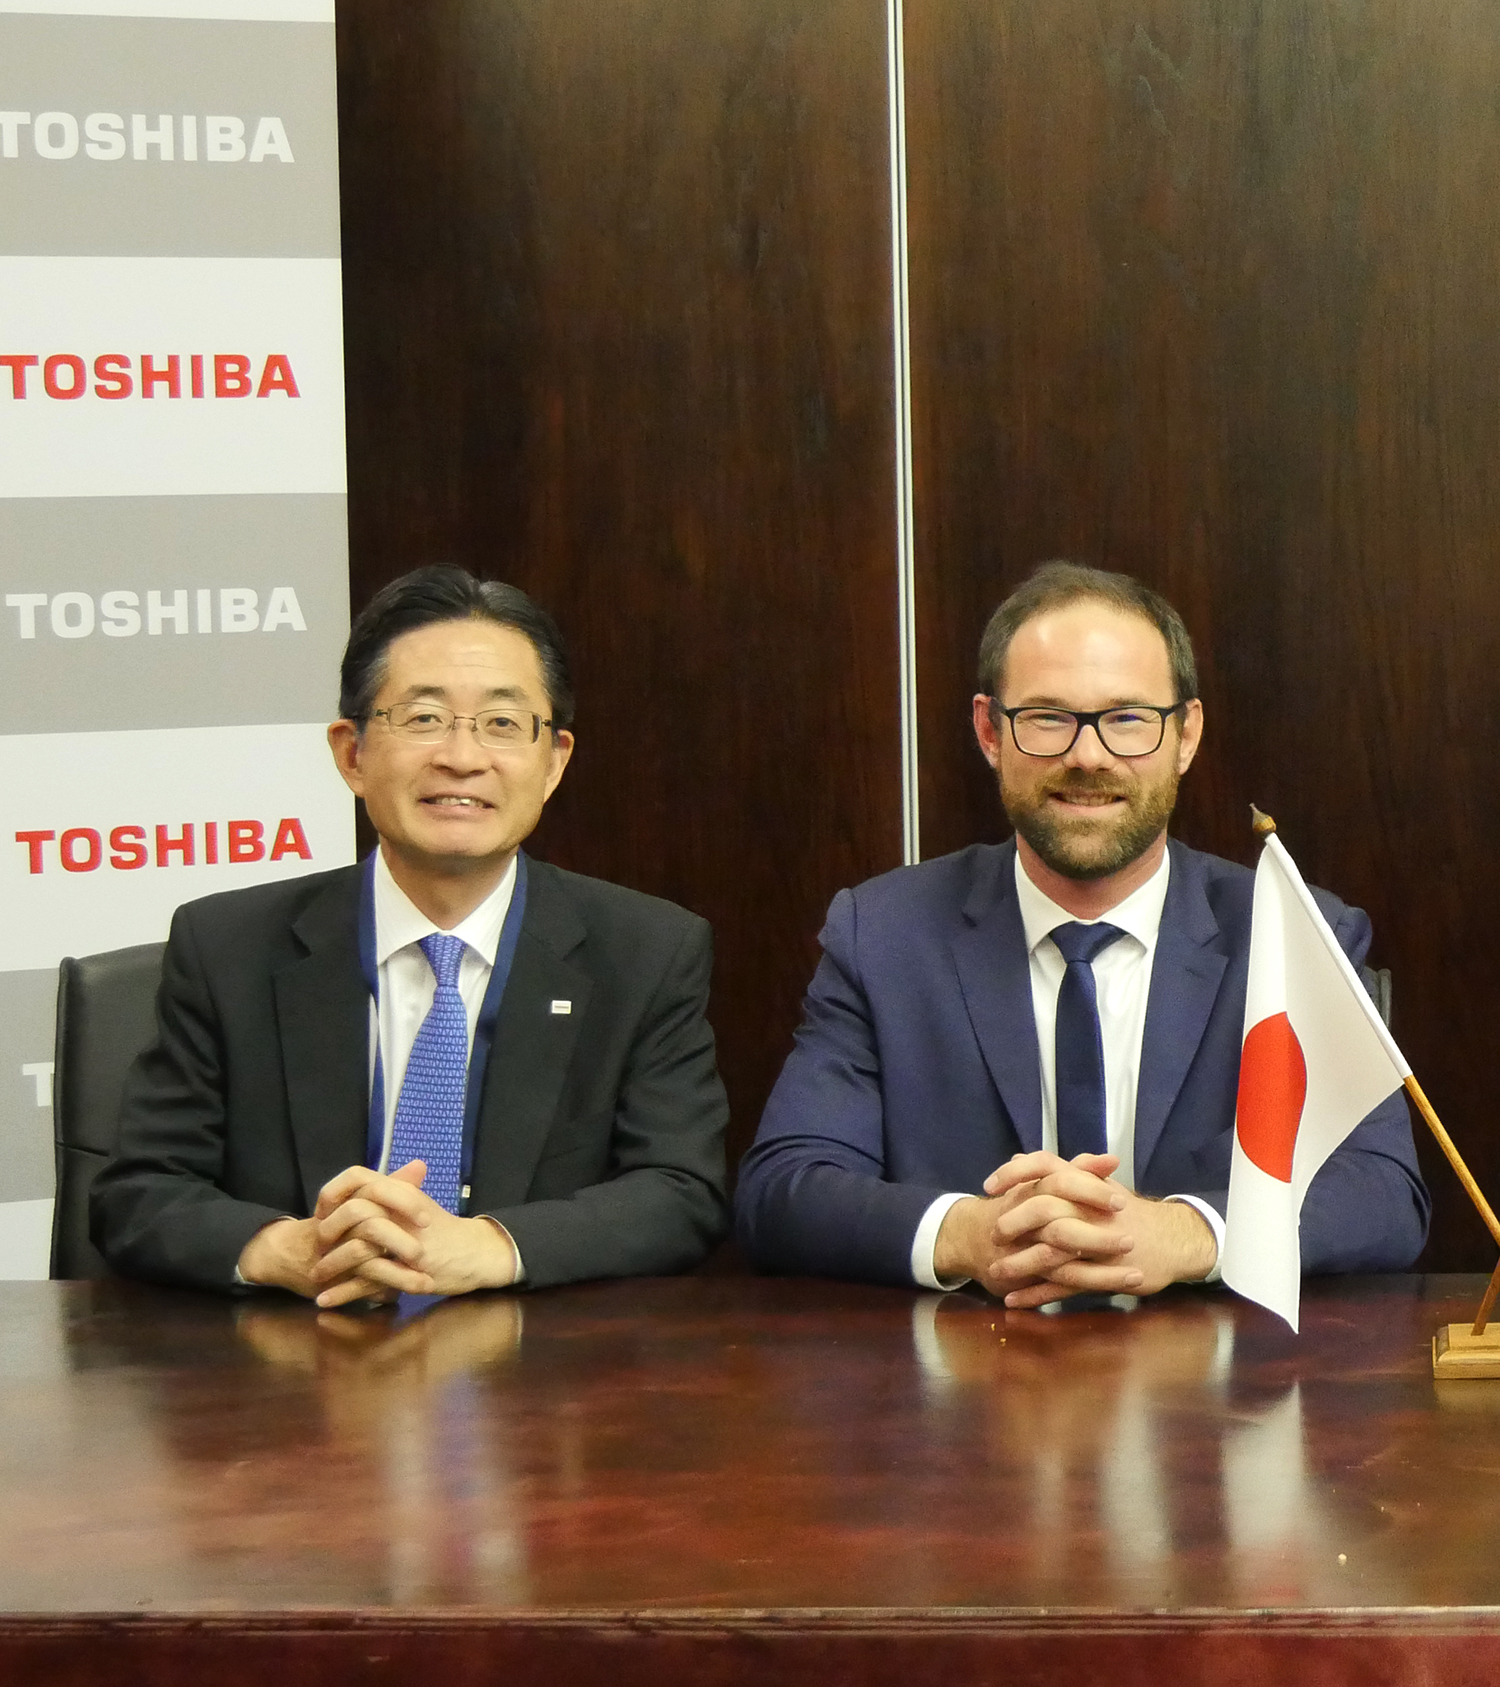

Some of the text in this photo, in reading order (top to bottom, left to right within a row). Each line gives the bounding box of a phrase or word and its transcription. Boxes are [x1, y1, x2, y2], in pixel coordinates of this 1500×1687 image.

[0, 111, 295, 163] TOSHIBA
[0, 354, 300, 400] TOSHIBA
[6, 587, 307, 639] TOSHIBA
[15, 818, 312, 874] TOSHIBA
